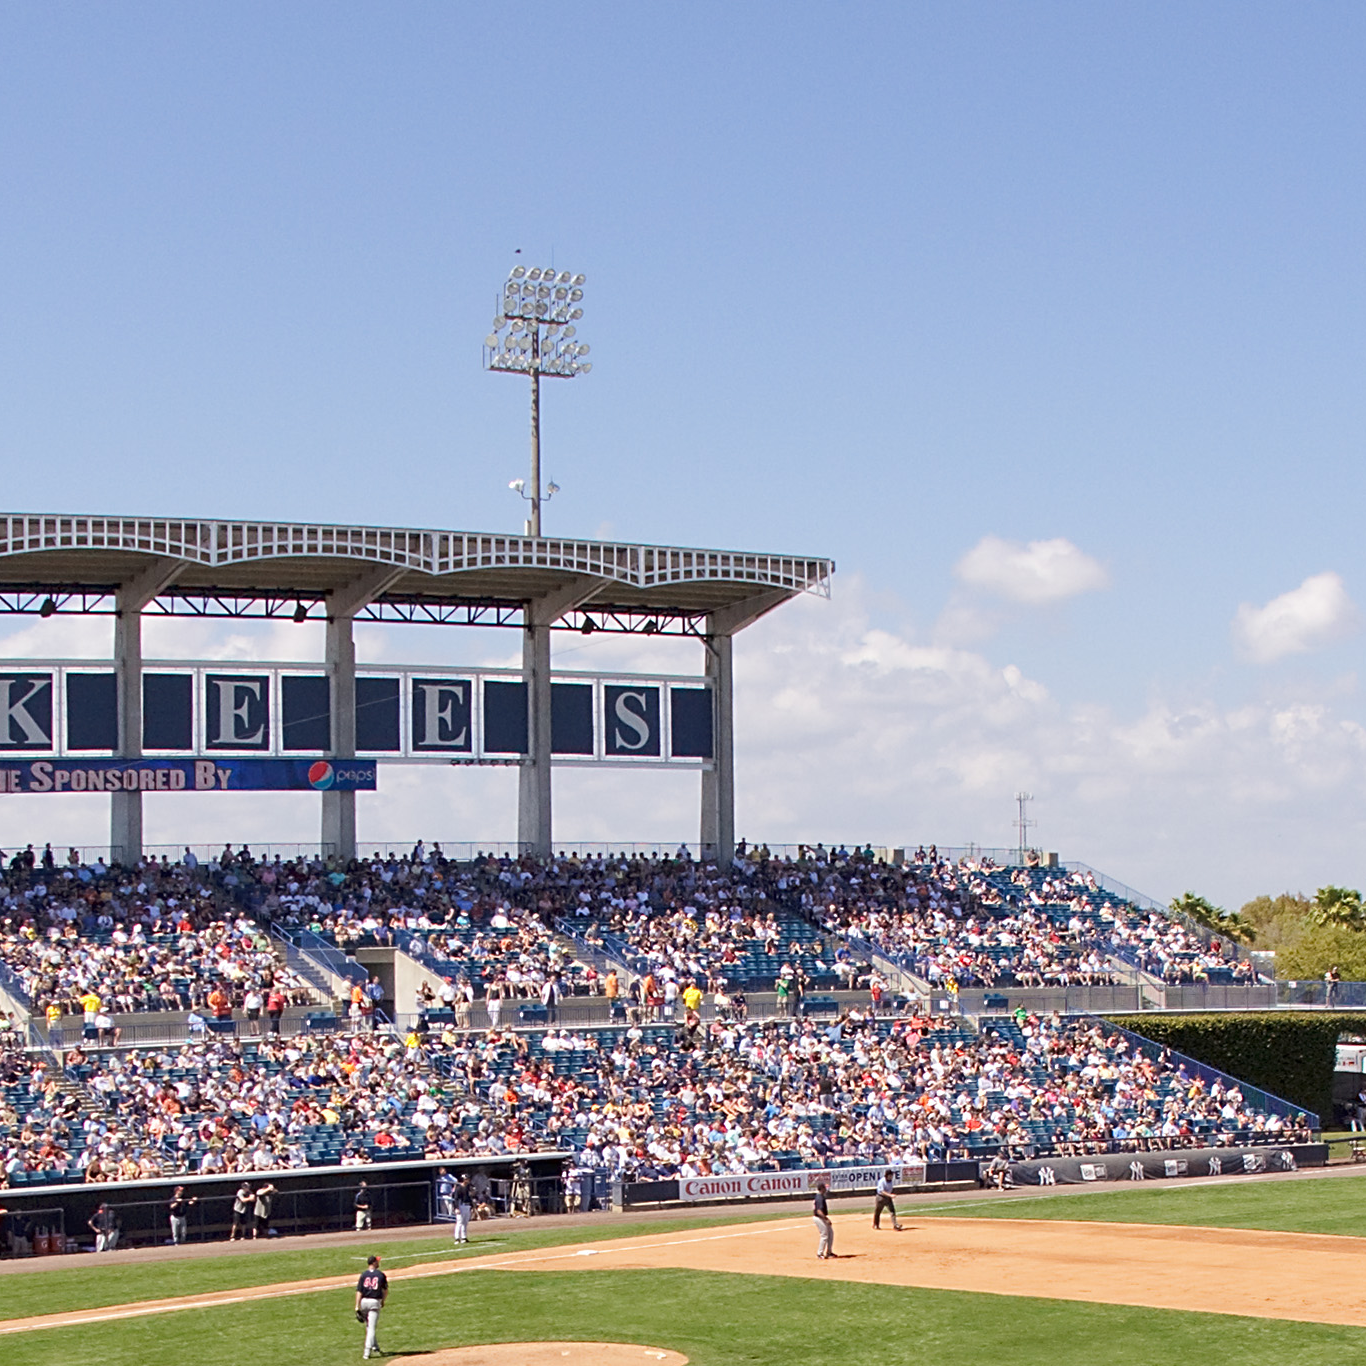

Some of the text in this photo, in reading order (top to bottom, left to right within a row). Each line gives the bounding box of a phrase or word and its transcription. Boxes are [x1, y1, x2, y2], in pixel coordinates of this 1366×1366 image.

[335, 767, 376, 784] pepsi
[685, 1177, 741, 1196] Canon
[747, 1175, 802, 1192] Canon
[848, 1172, 876, 1183] OPEN
